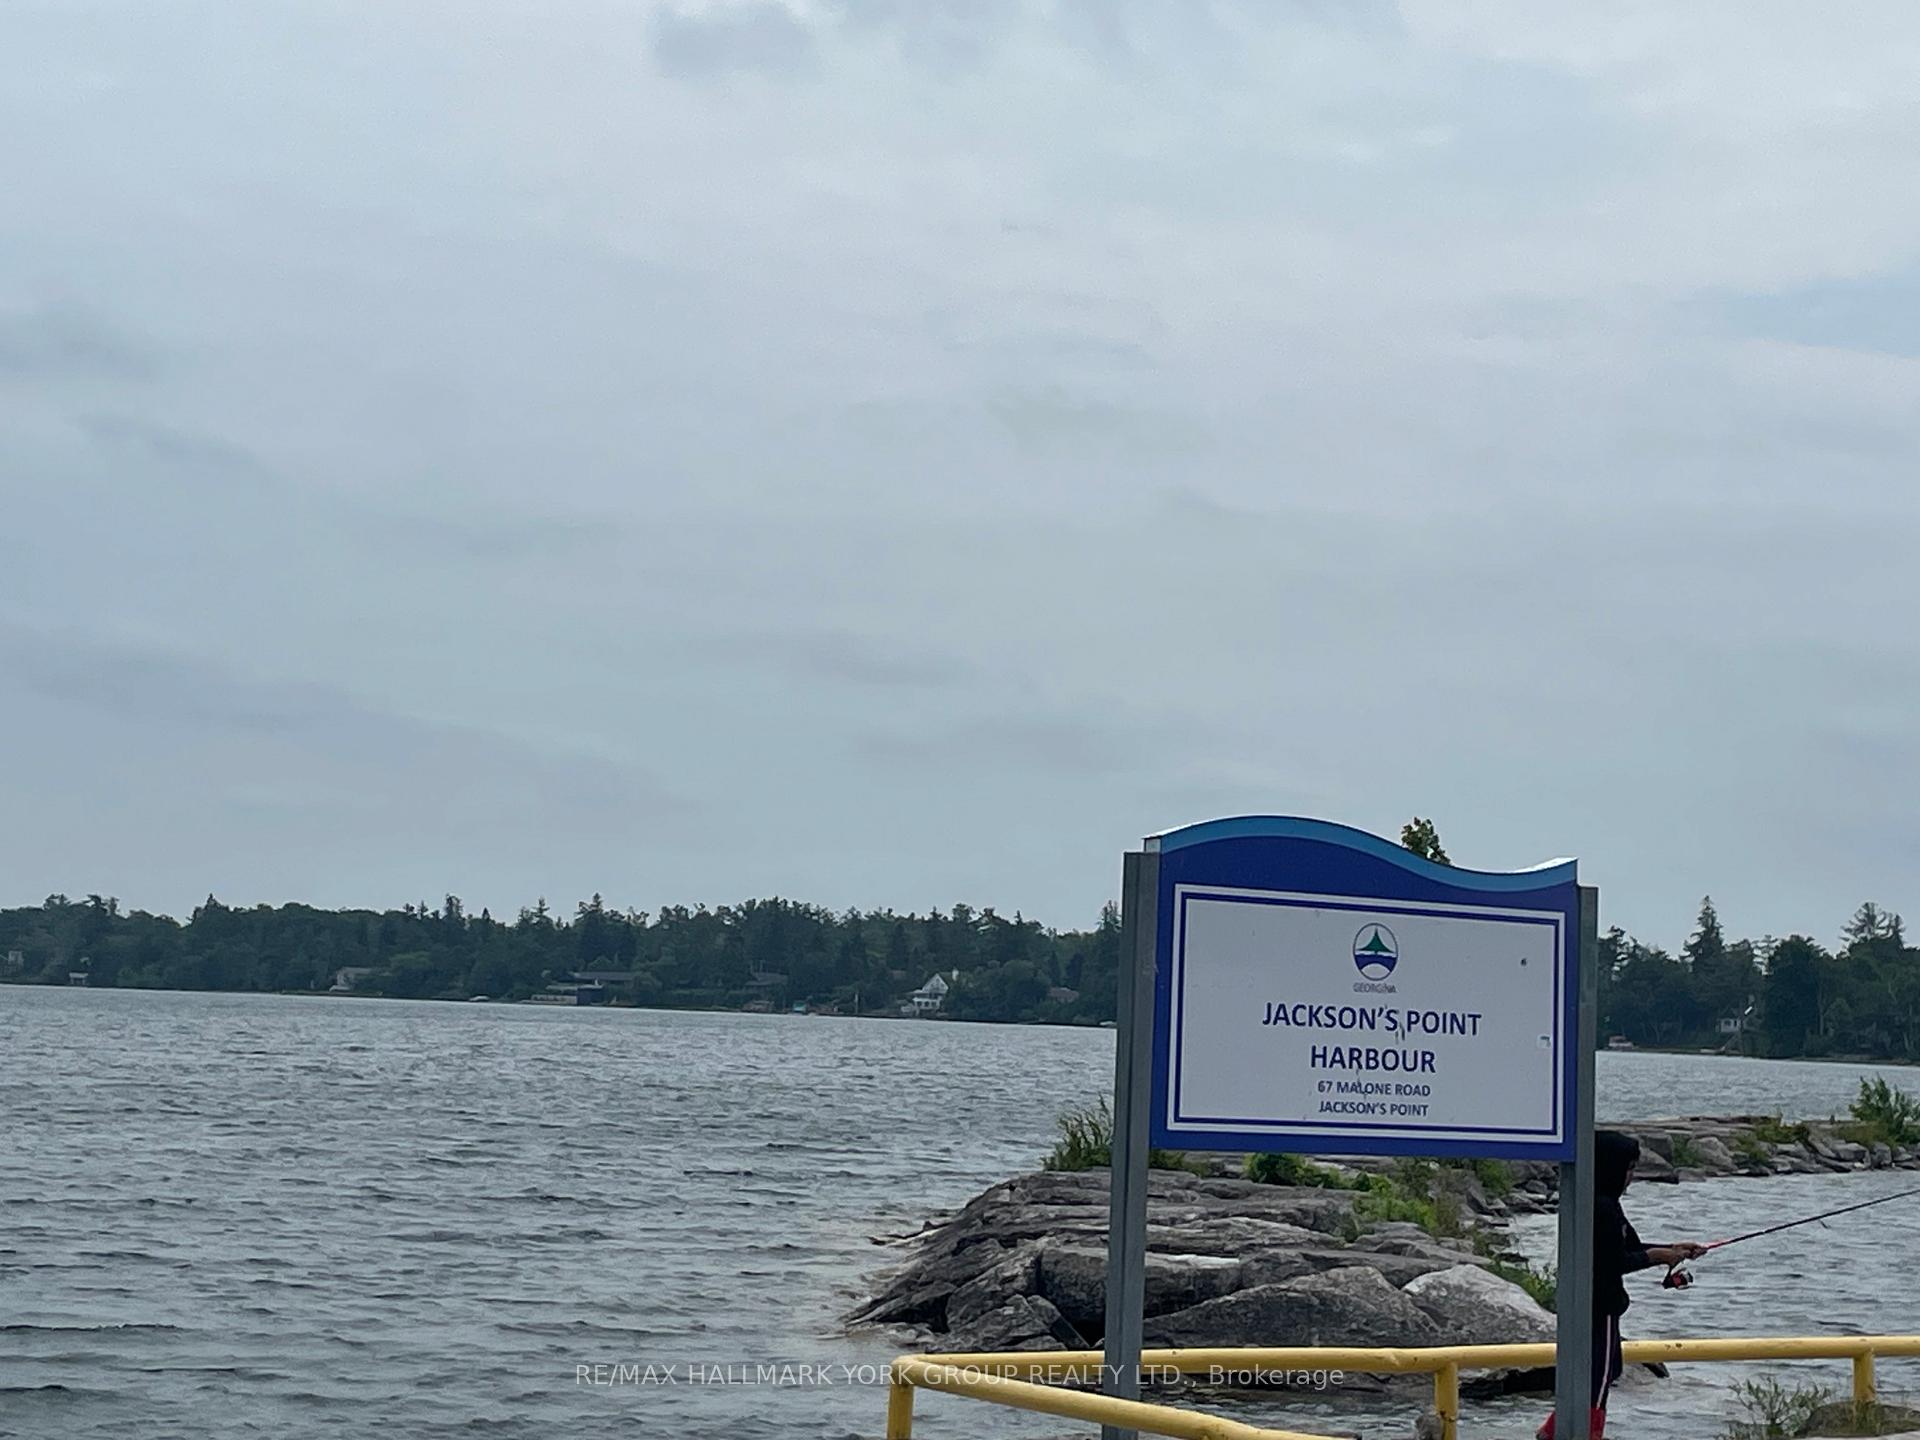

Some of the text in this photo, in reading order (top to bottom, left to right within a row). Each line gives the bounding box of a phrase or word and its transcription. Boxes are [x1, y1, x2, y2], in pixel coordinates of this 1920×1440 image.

[1353, 982, 1397, 994] GEORGINA
[1262, 1002, 1482, 1036] JACKSON'S POINT
[1310, 1045, 1436, 1073] HARBOUR
[1317, 1080, 1431, 1097] 67 MALONE ROAD
[1318, 1101, 1429, 1117] JACKSON'S POINT
